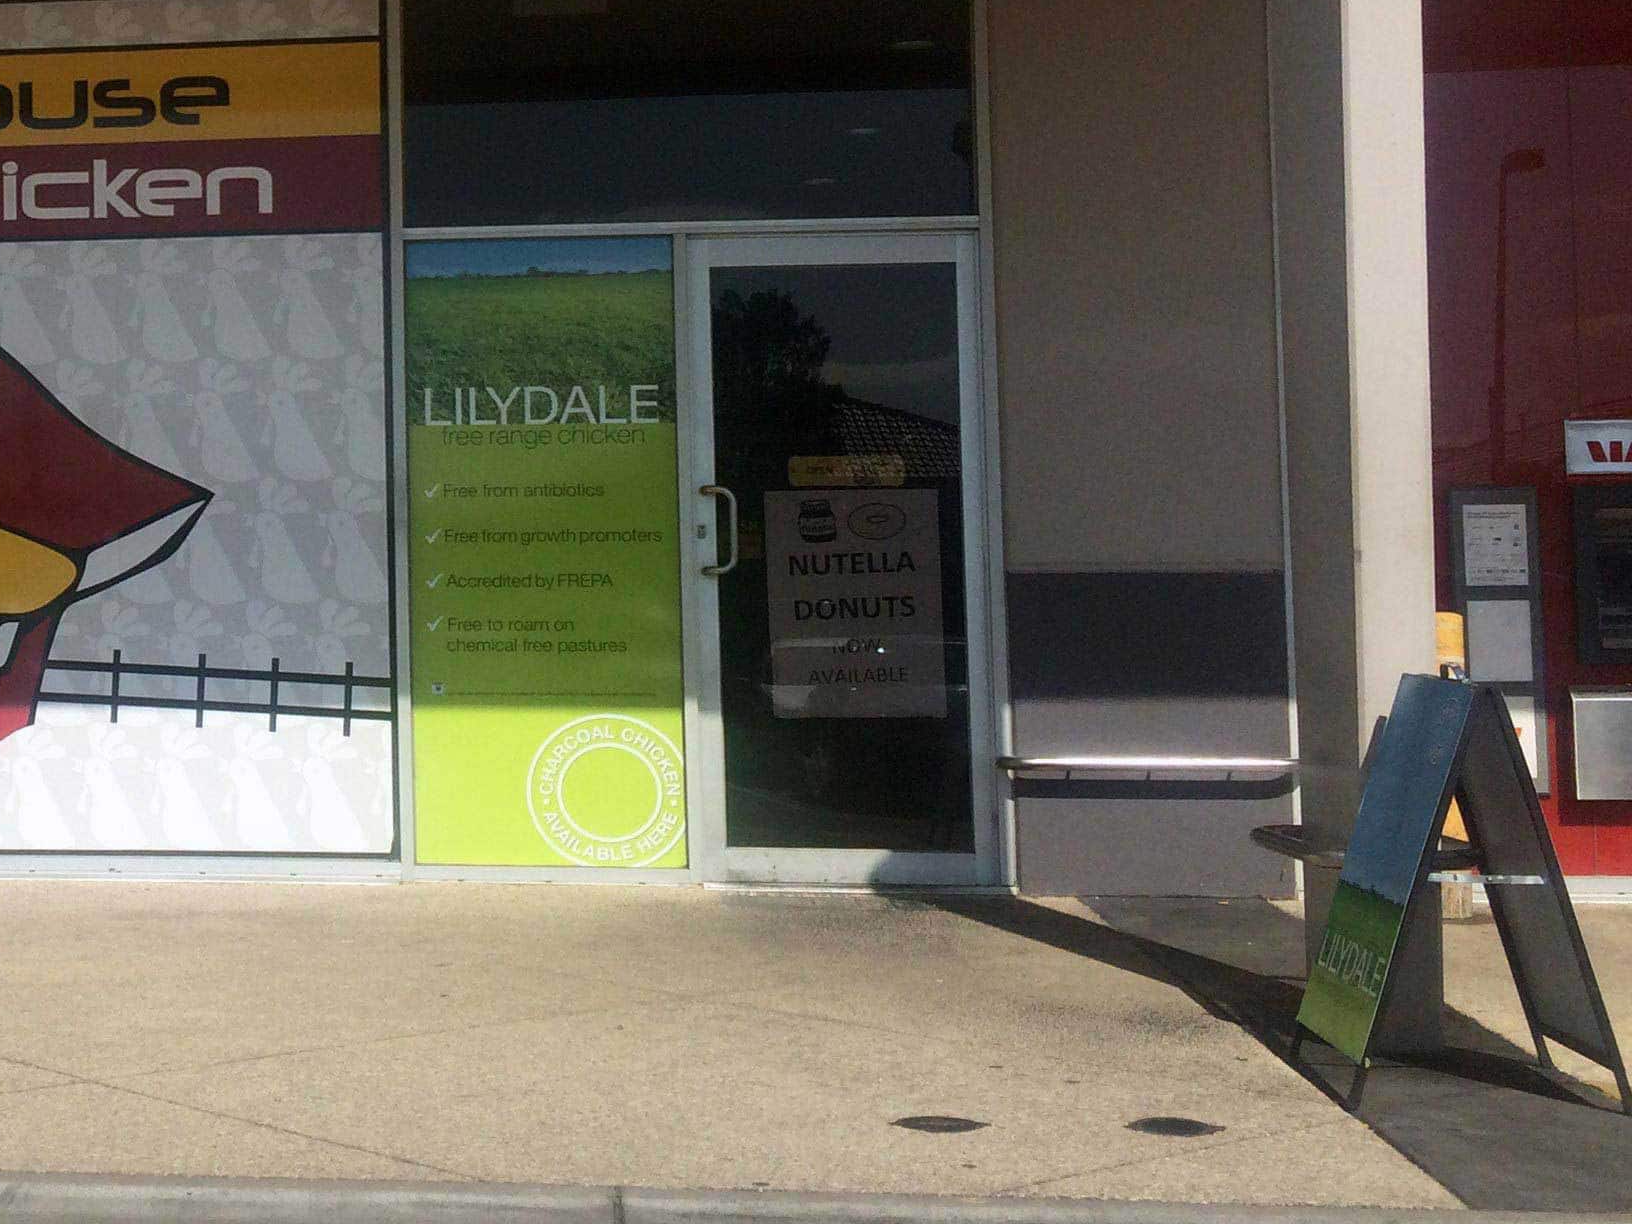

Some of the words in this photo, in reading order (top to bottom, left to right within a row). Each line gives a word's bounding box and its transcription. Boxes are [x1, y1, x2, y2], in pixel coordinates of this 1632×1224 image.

[424, 385, 659, 426] LILYDALE
[442, 426, 483, 445] free
[489, 430, 552, 449] range
[558, 426, 646, 444] chicken
[443, 484, 478, 498] Free
[483, 484, 518, 497] from
[524, 482, 604, 497] antibiotics
[444, 529, 478, 543] Free
[482, 529, 518, 543] from
[521, 528, 576, 546] growth
[579, 529, 662, 546] promoters
[788, 551, 916, 576] NUTELLA
[446, 574, 533, 589] Accredited
[535, 574, 554, 591] by
[557, 574, 613, 588] FREPA
[794, 596, 915, 620] DONUTS
[448, 618, 482, 632] Free
[487, 618, 503, 632] to
[508, 620, 549, 632] roam
[554, 619, 574, 632] on
[447, 638, 517, 653] chemical
[523, 639, 553, 653] free
[557, 640, 627, 656] pastures
[833, 638, 880, 655] NOW
[808, 667, 909, 685] AVAILABLE
[540, 726, 615, 795] CHARCOAL
[621, 728, 680, 796] CHICKEN
[544, 812, 634, 861] AVAILABLE
[1318, 929, 1386, 998] LILYDALE
